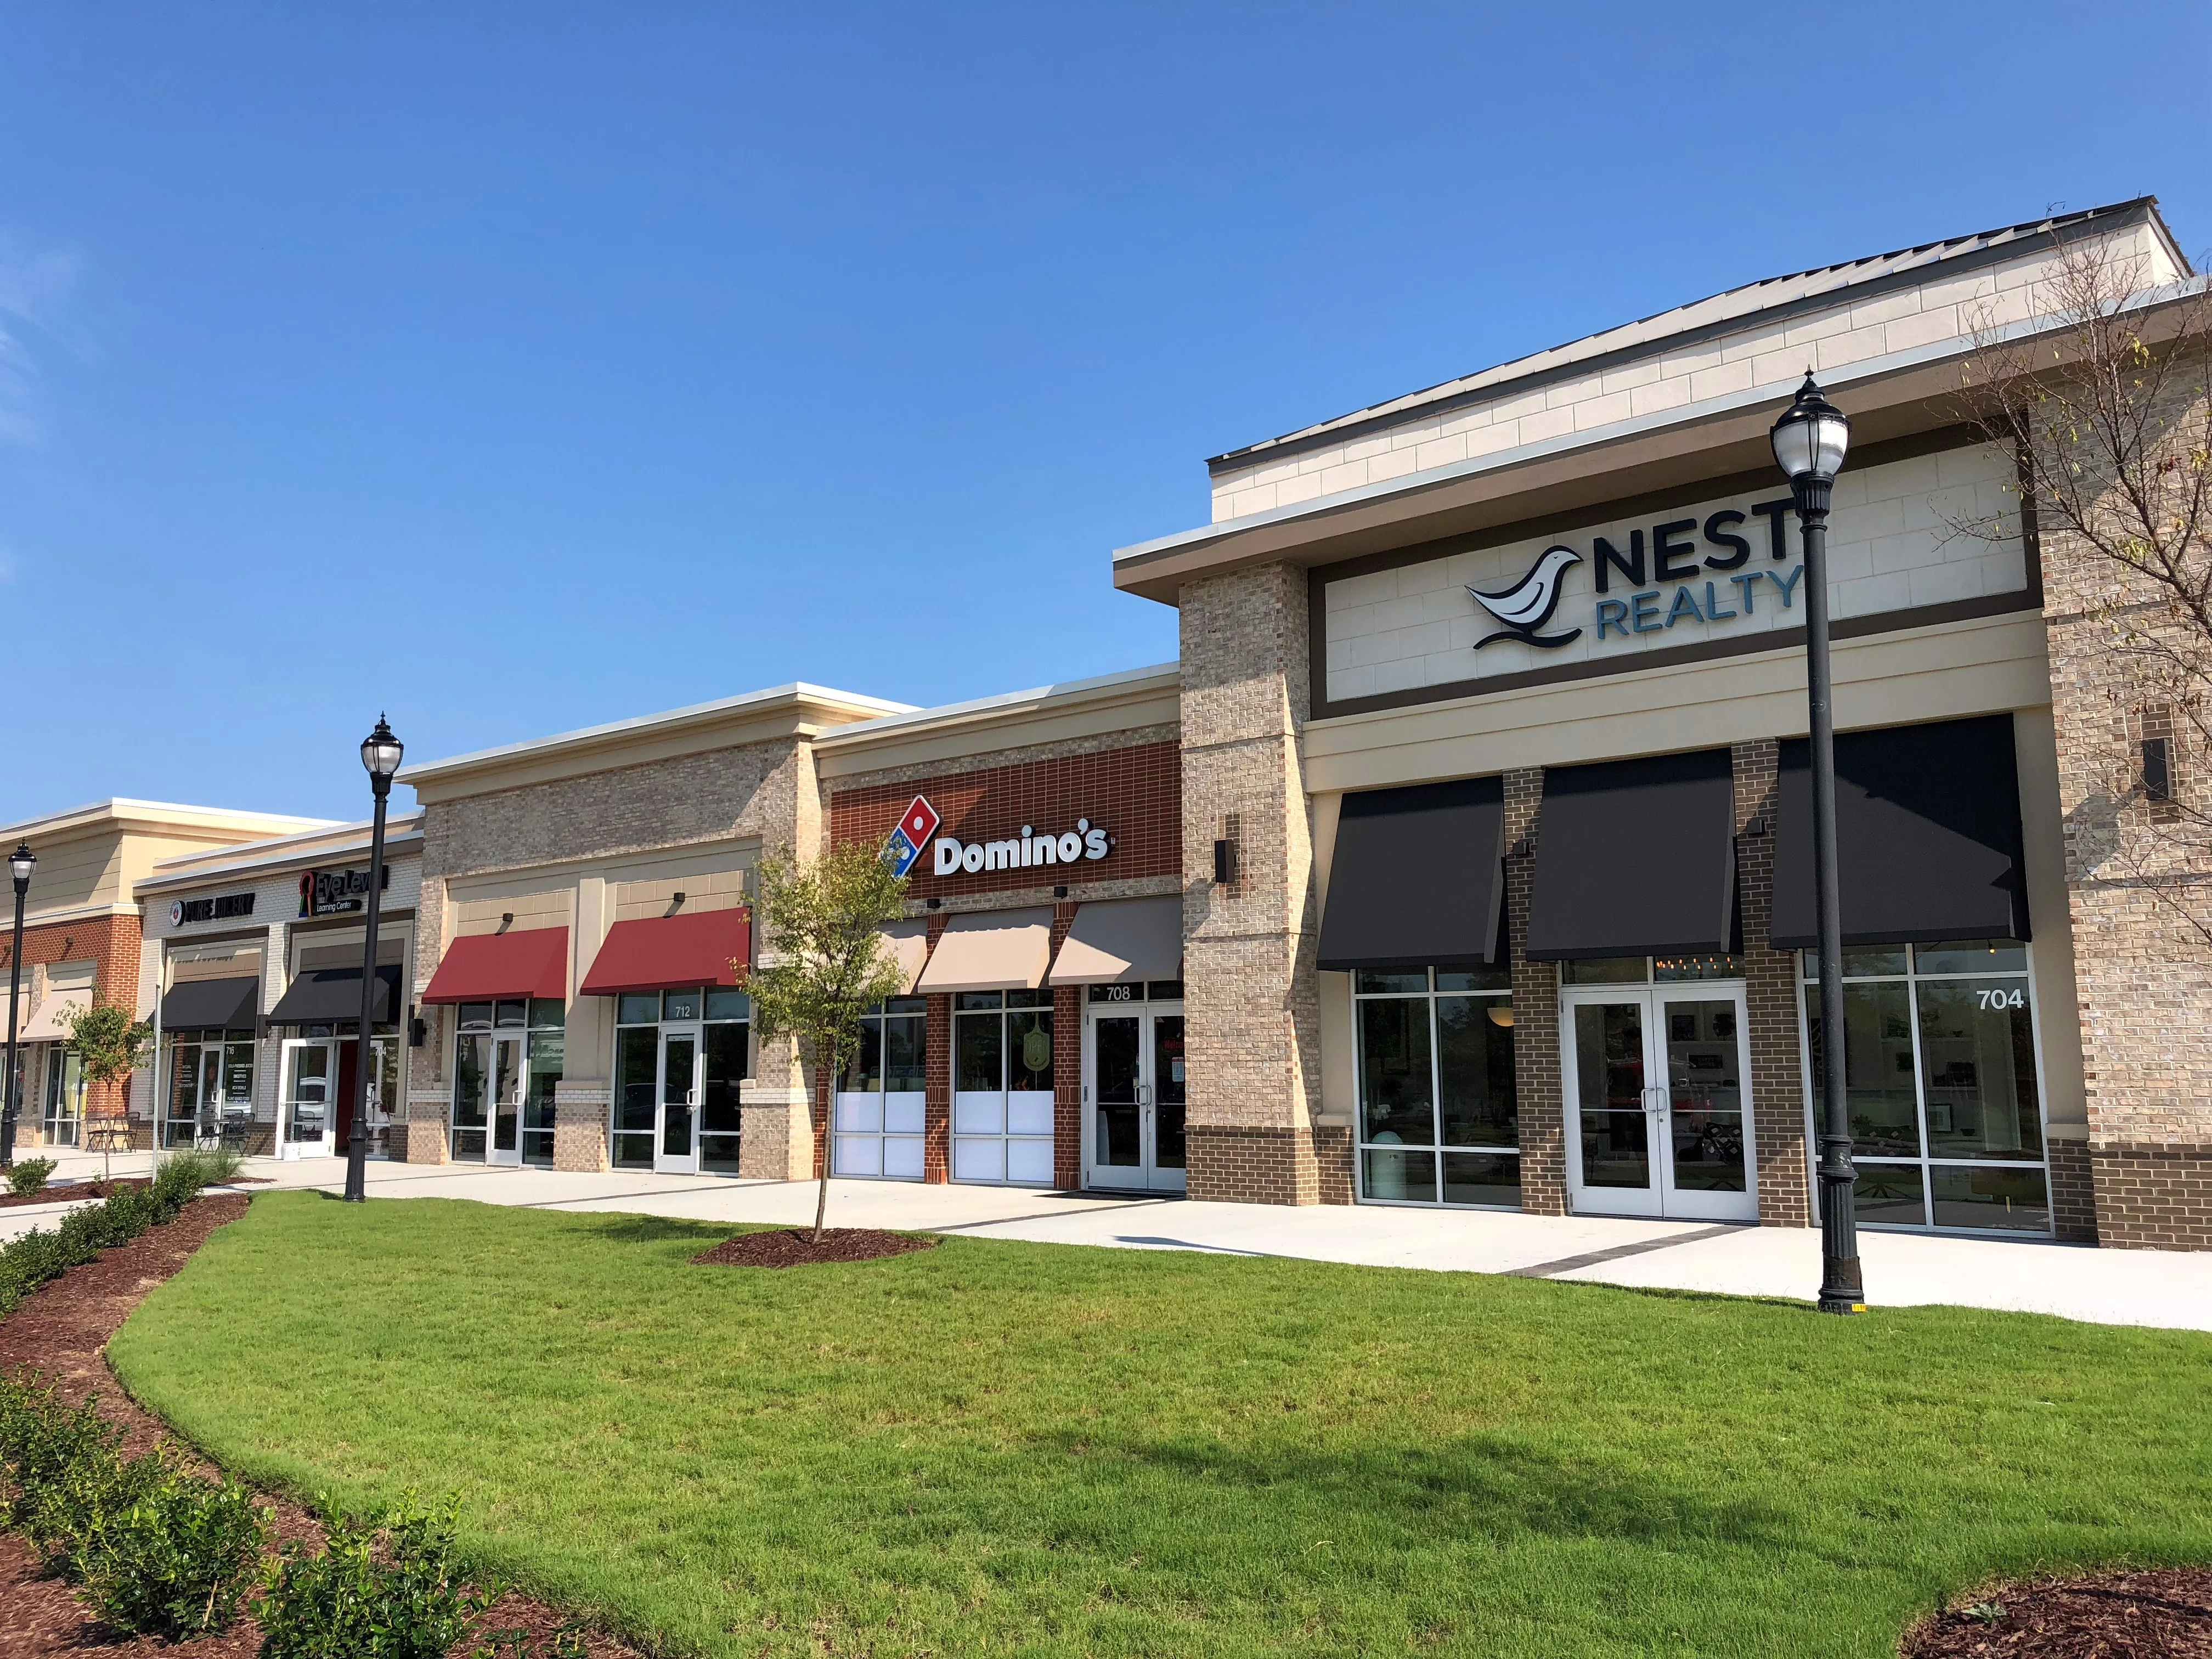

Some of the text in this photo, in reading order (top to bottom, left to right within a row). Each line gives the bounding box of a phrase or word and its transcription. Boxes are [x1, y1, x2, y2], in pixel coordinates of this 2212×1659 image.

[1593, 497, 1796, 594] NEST
[1596, 565, 1804, 640] REALTY
[934, 818, 1108, 876] Domino's
[185, 899, 213, 922] PURE
[212, 893, 255, 918] JUICERY
[317, 901, 352, 912] Learning Center
[1107, 986, 1130, 1001] 708
[1976, 989, 2024, 1009] 704
[675, 1006, 690, 1018] 712
[226, 1046, 235, 1055] 716
[1025, 1040, 1048, 1053] OPEN
